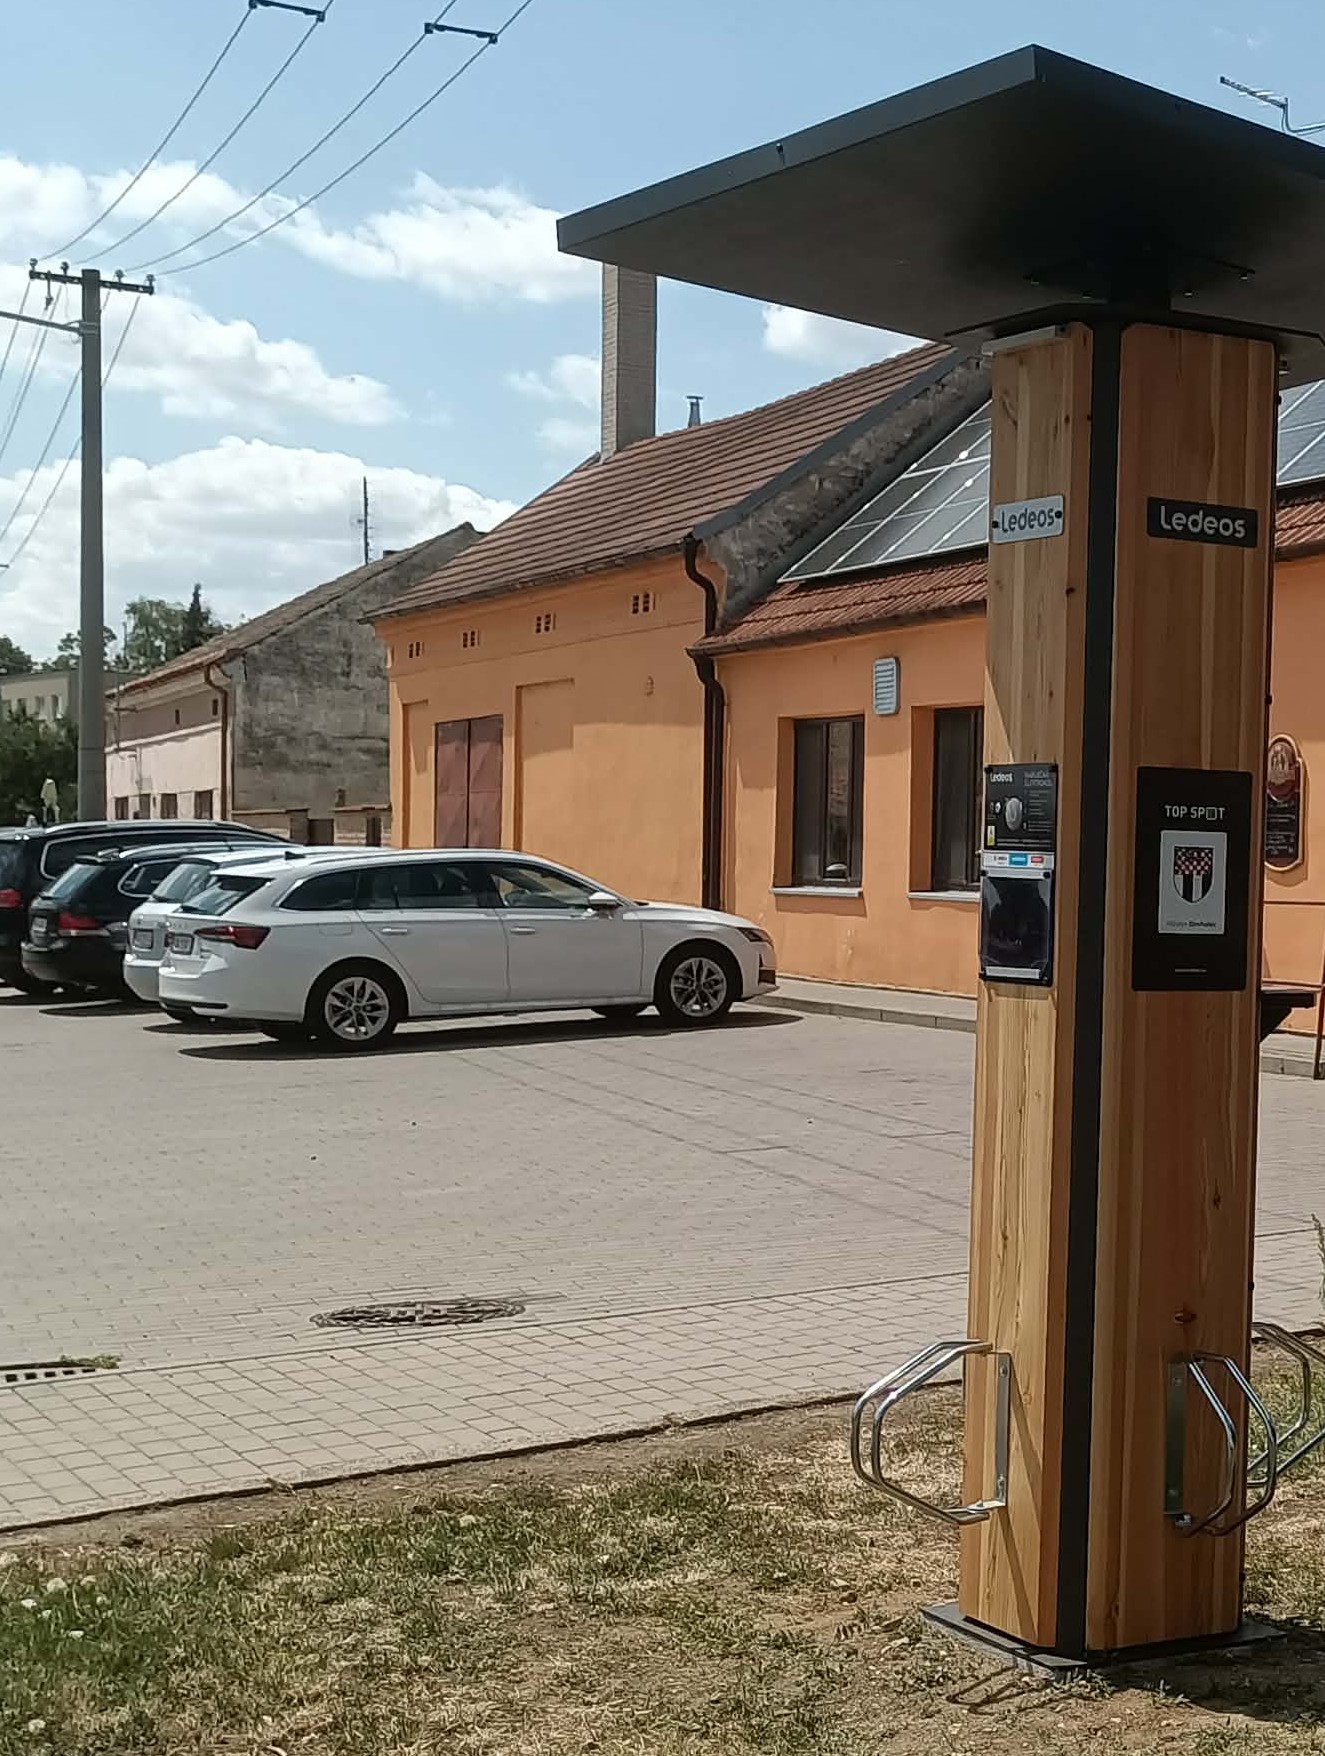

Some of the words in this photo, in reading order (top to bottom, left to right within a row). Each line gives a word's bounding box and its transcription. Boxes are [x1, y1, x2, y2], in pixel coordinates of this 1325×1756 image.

[1001, 507, 1055, 533] Ledeos
[1159, 505, 1247, 539] Ledeos
[1164, 804, 1188, 818] TOP
